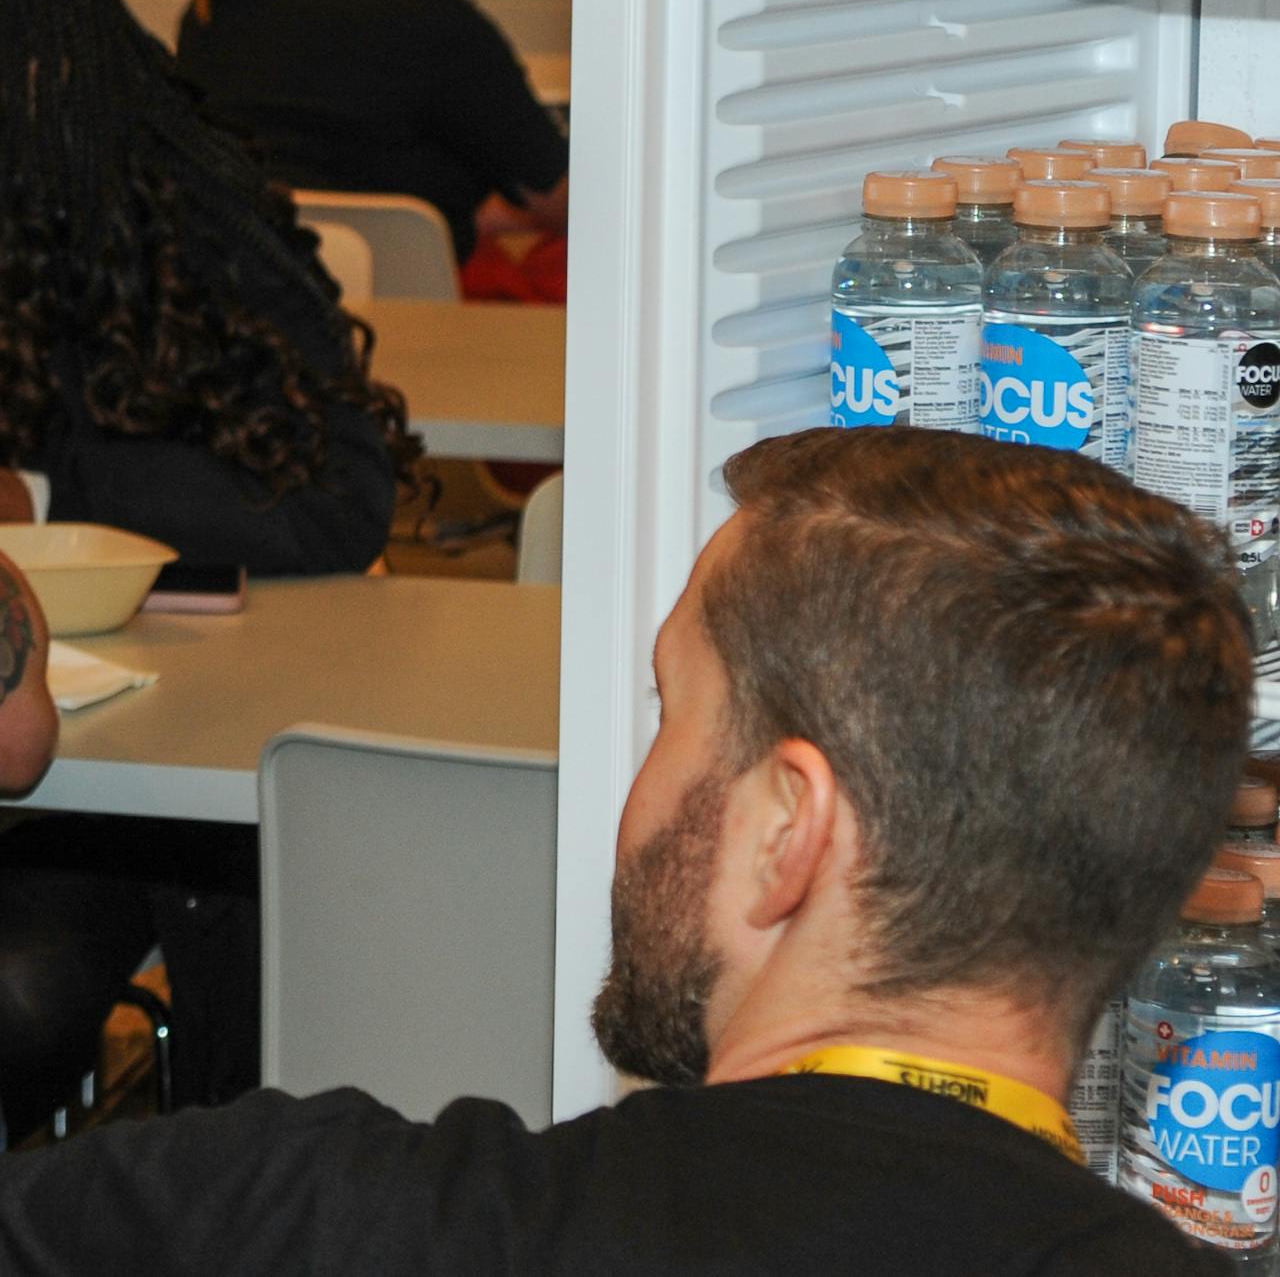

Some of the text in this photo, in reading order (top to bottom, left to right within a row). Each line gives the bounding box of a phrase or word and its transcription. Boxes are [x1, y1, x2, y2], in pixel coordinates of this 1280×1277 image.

[830, 361, 900, 416] CUS
[1236, 364, 1280, 384] FOCU
[1156, 1043, 1258, 1071] VITAMIN
[1147, 1074, 1280, 1132] FOCU
[1151, 1129, 1262, 1168] WATER
[1152, 1181, 1206, 1208] PUSH
